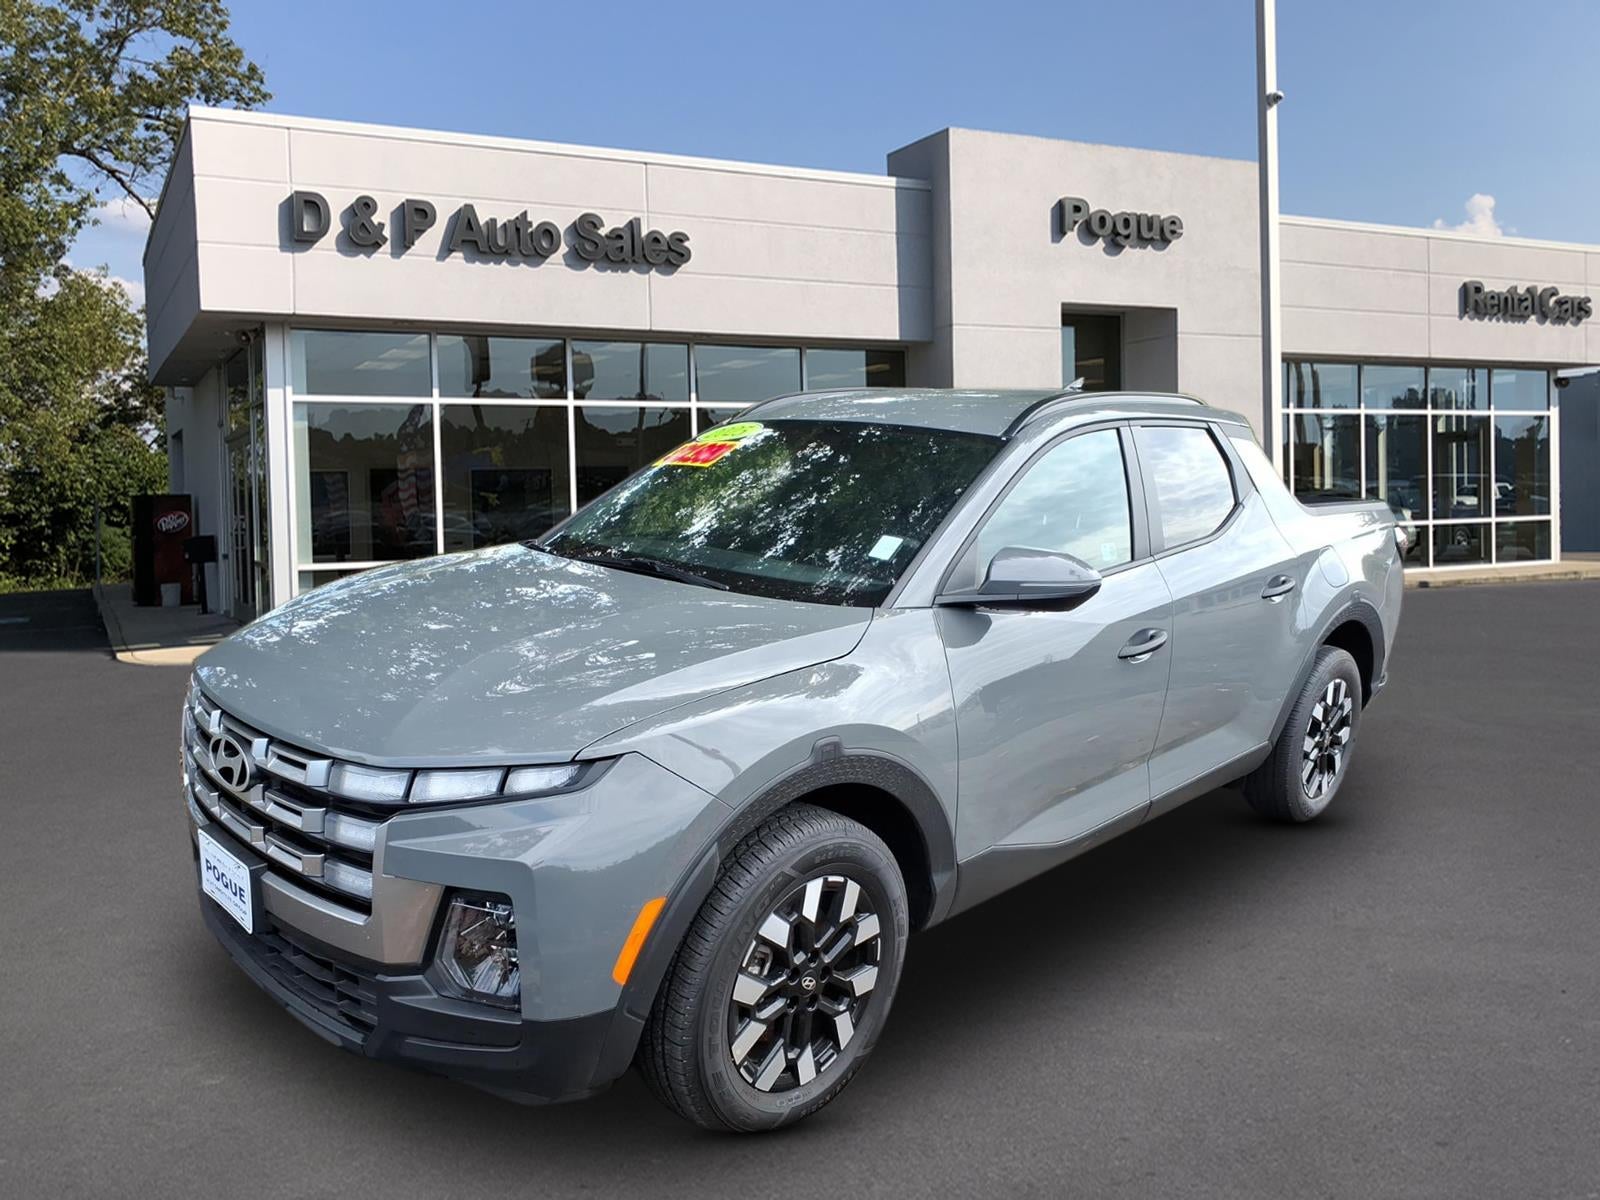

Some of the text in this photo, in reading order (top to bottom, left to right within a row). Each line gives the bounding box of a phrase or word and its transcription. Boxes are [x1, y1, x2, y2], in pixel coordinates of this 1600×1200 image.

[291, 190, 692, 268] D & P Auto Sales
[1060, 196, 1184, 247] Pogue
[1463, 280, 1593, 321] Rental Cars
[205, 858, 246, 905] POGUE
